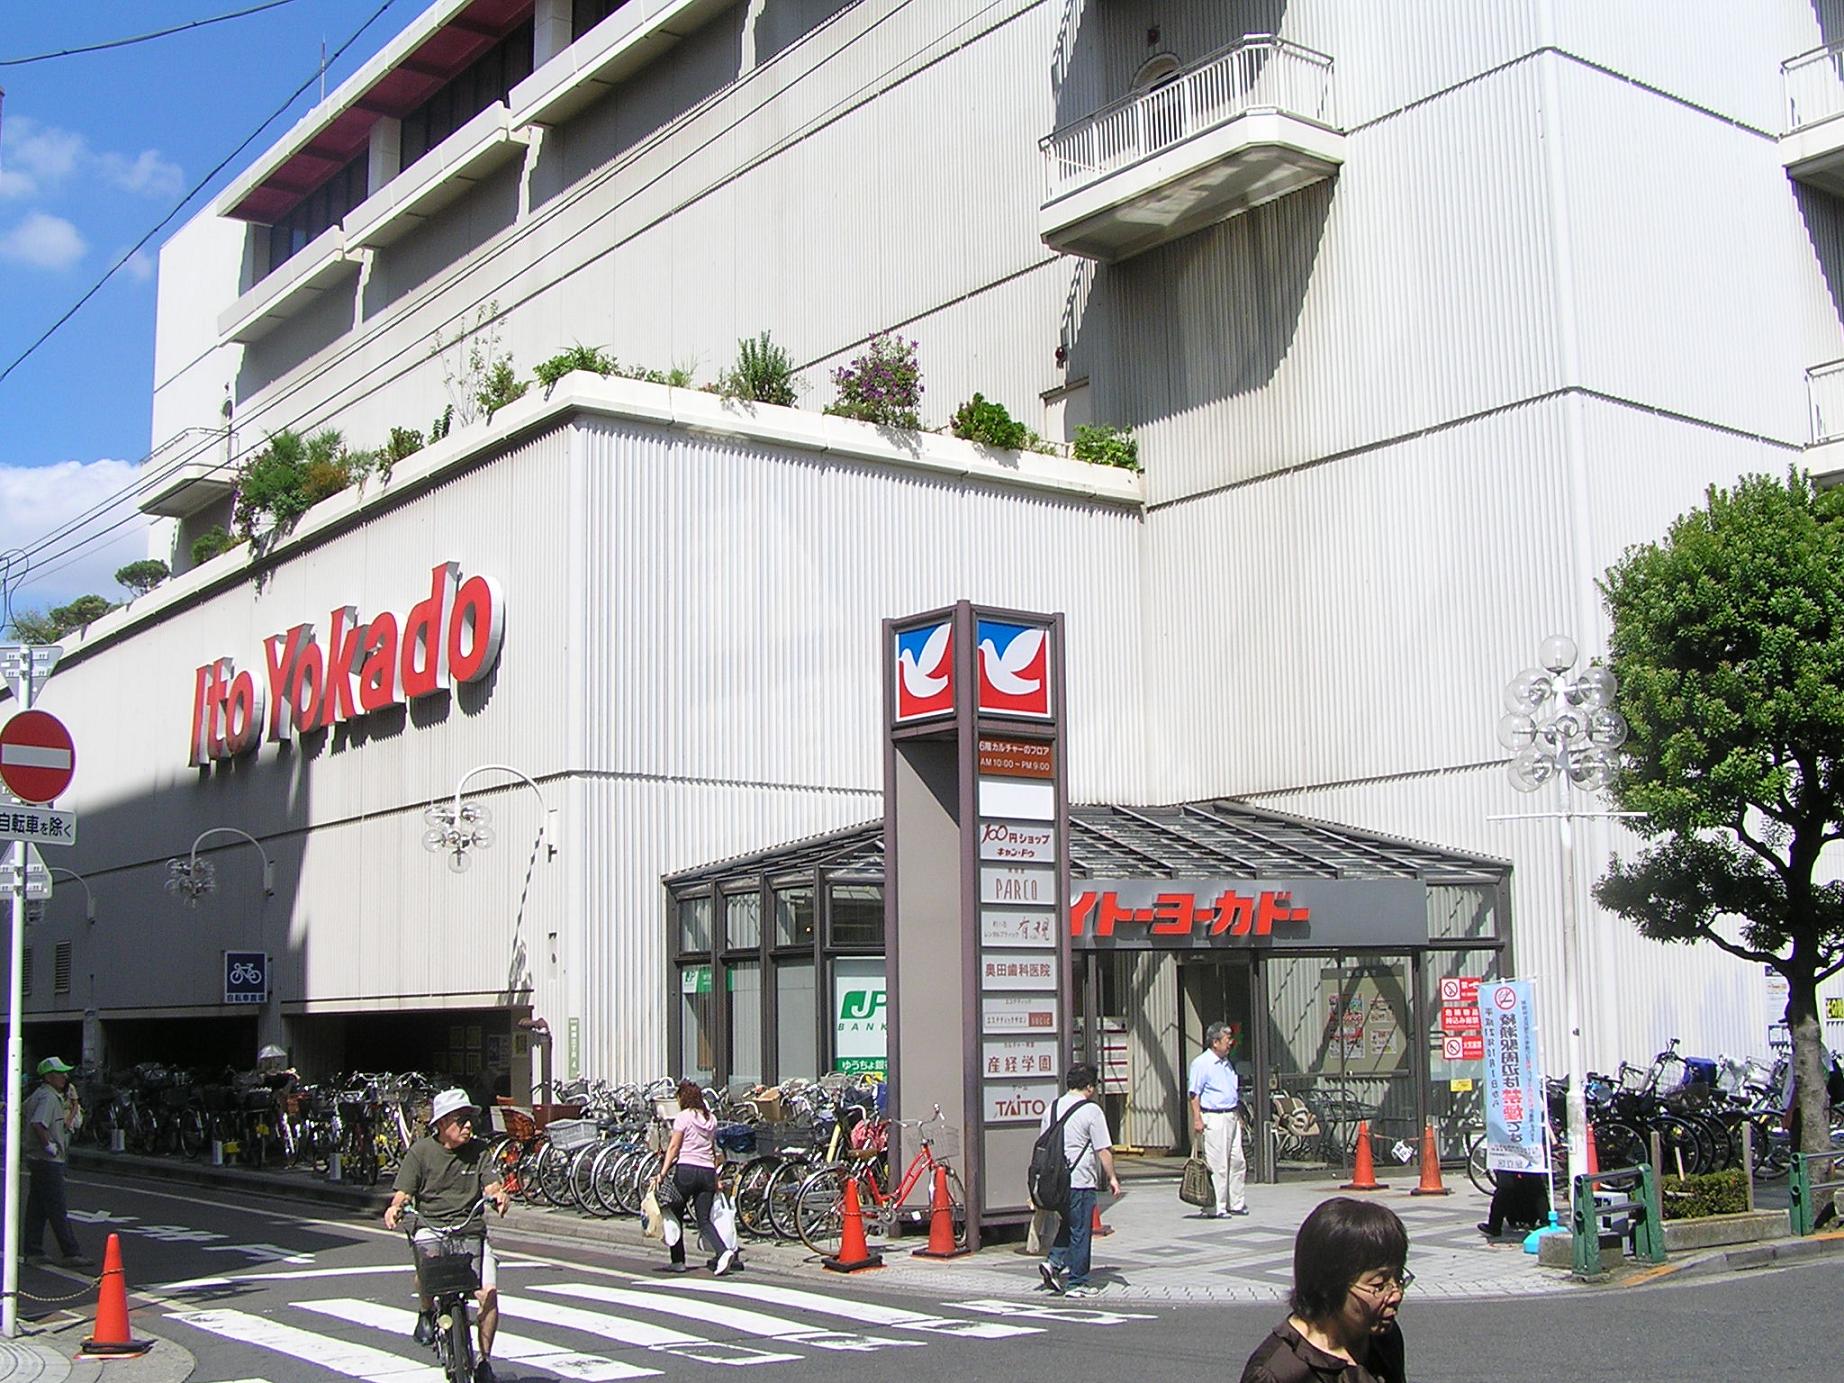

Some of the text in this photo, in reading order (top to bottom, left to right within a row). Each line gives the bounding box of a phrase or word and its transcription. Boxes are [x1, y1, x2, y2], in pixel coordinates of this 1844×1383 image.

[188, 561, 502, 768] Ito Yokado
[980, 758, 993, 767] AM
[993, 759, 1014, 769] 10:00
[1021, 760, 1033, 769] PM
[1033, 761, 1050, 771] 9:00
[0, 812, 72, 838] 自転車を除く
[982, 823, 1050, 844] 100円ショップ
[996, 878, 1038, 900] PARCO
[1071, 890, 1310, 937] イトーヨーカドー
[985, 963, 1051, 978] 奥田歯科医院
[988, 1055, 1051, 1073] 産経学園
